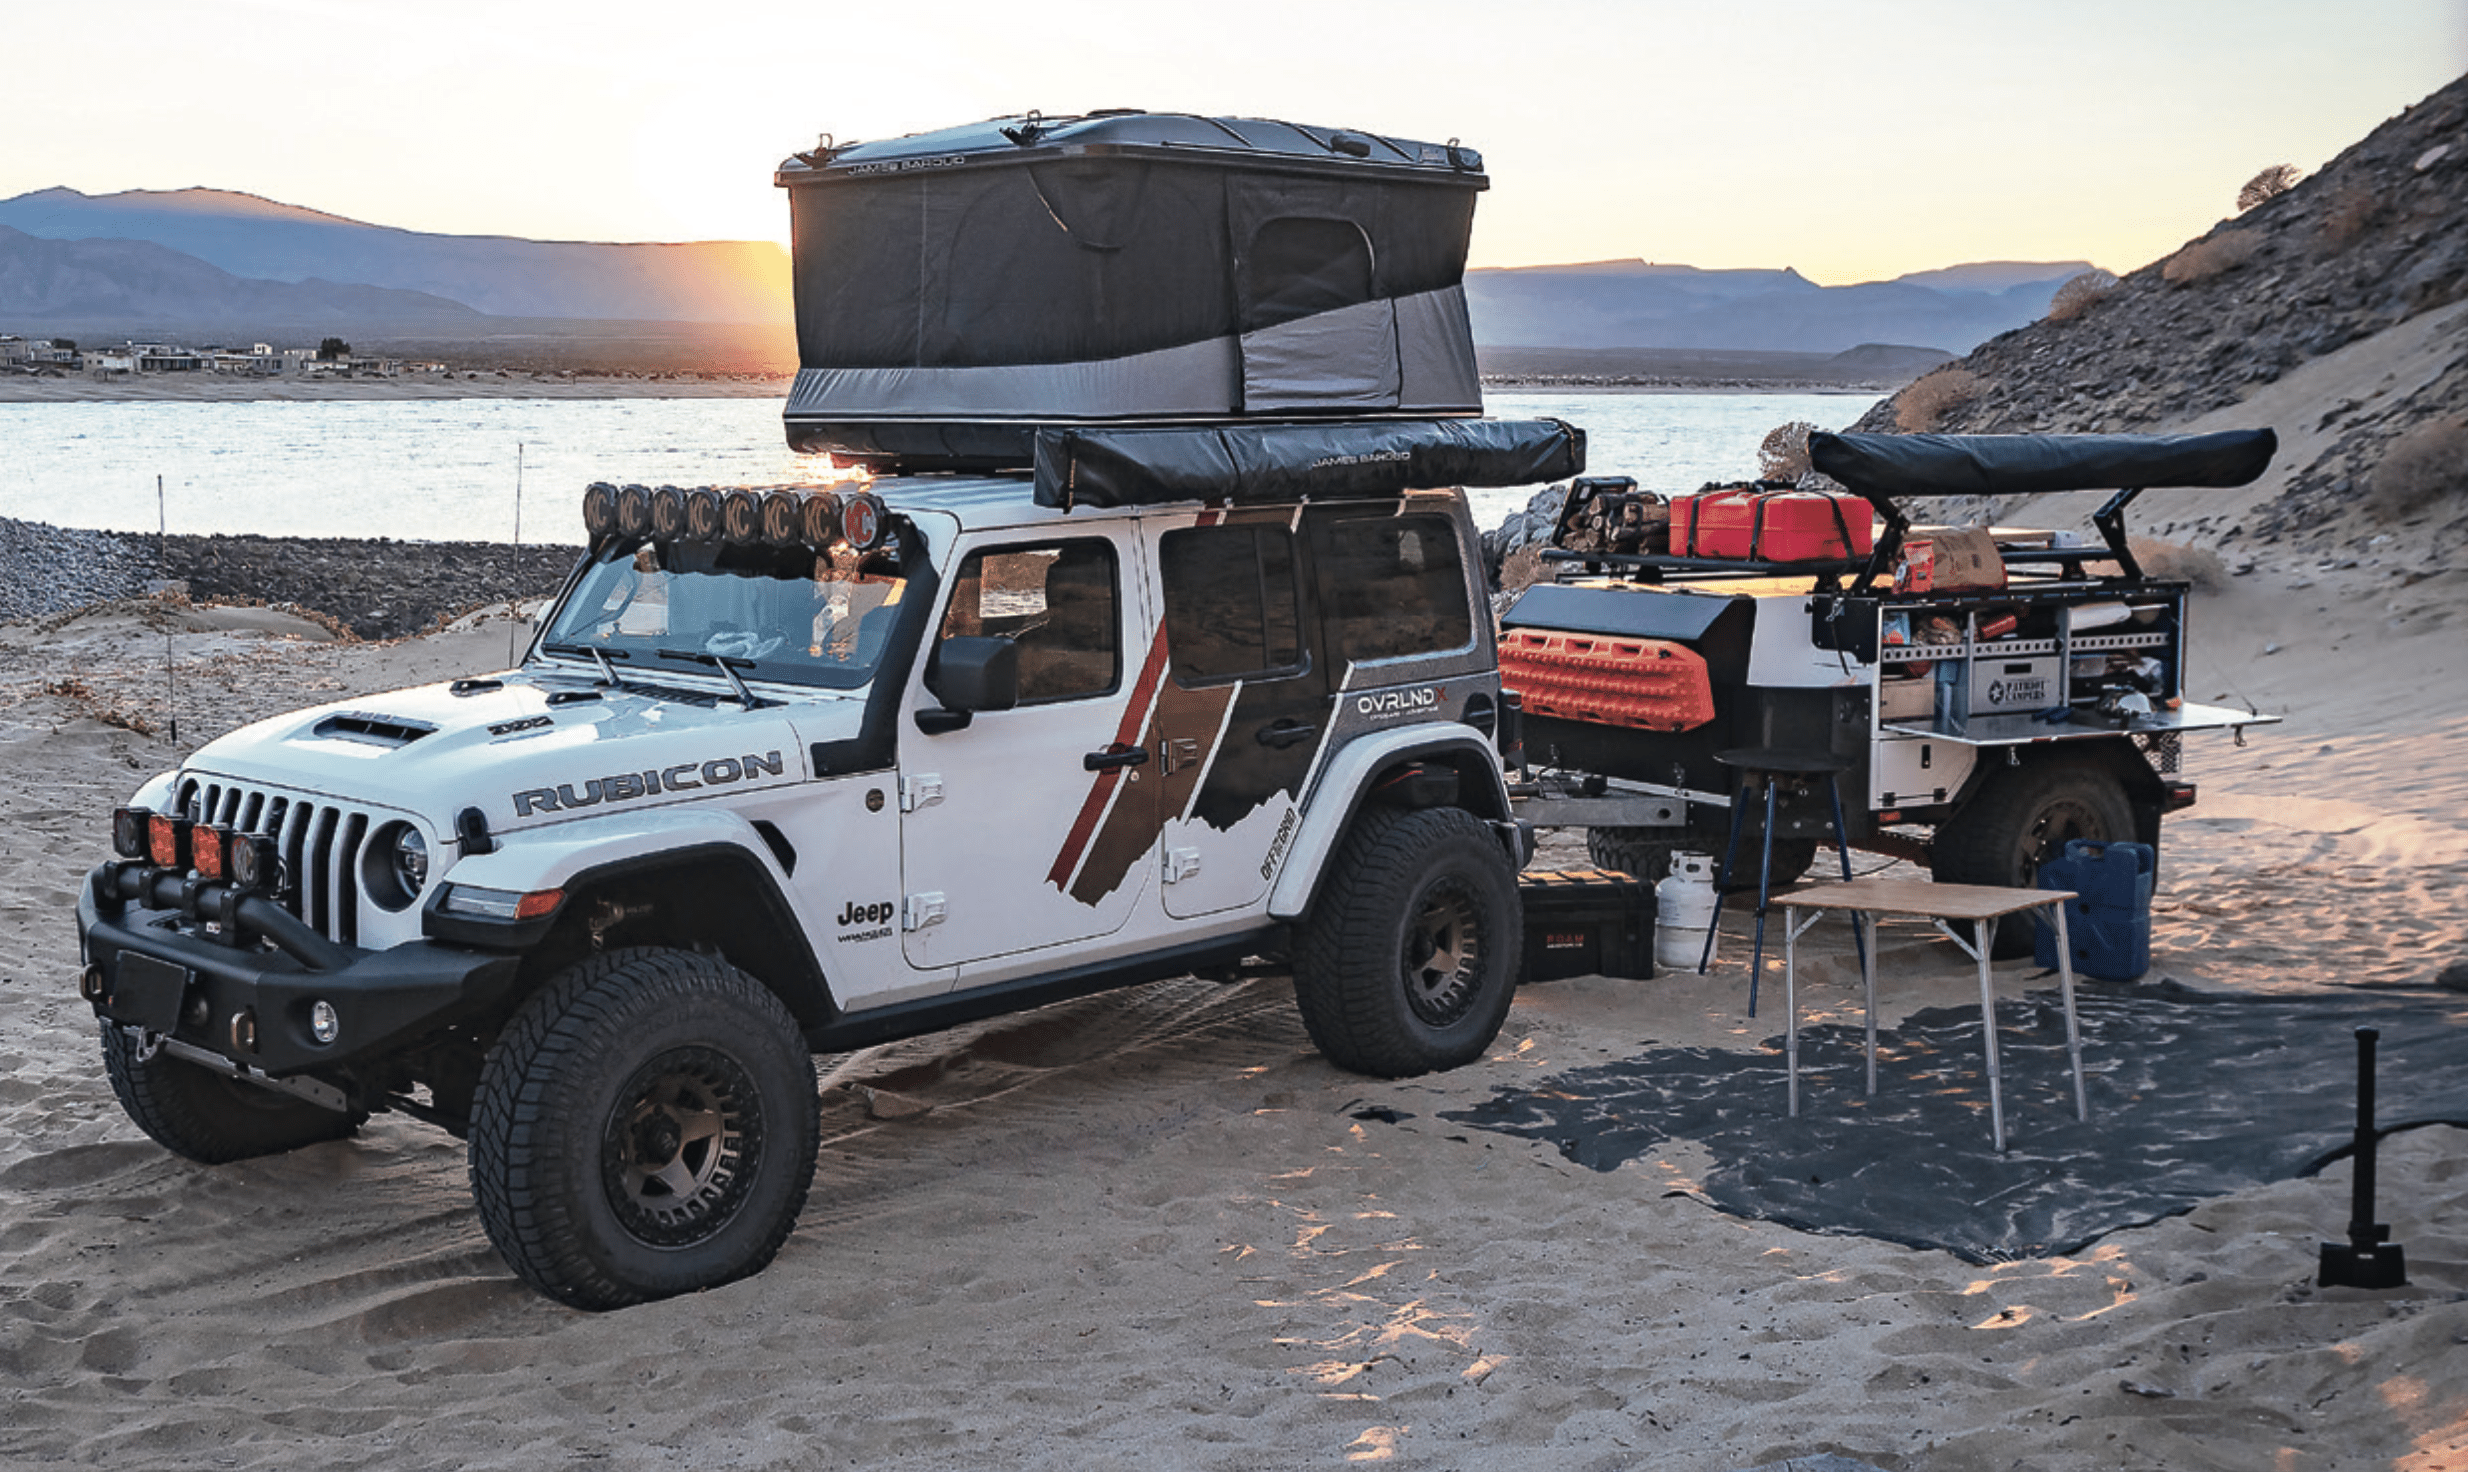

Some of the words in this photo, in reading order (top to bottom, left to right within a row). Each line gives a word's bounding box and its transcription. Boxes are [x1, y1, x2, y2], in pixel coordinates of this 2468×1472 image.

[1312, 455, 1358, 468] JAMES
[1360, 450, 1411, 463] BAROUD
[586, 491, 608, 528] KC
[620, 492, 641, 531] KC
[654, 494, 675, 533] KC
[688, 495, 711, 535] KC
[725, 497, 749, 539] KC
[764, 498, 789, 540] KC
[804, 500, 830, 542] KC
[845, 501, 872, 545] KC
[512, 750, 784, 817] RUBICON
[837, 901, 895, 926] Jeep
